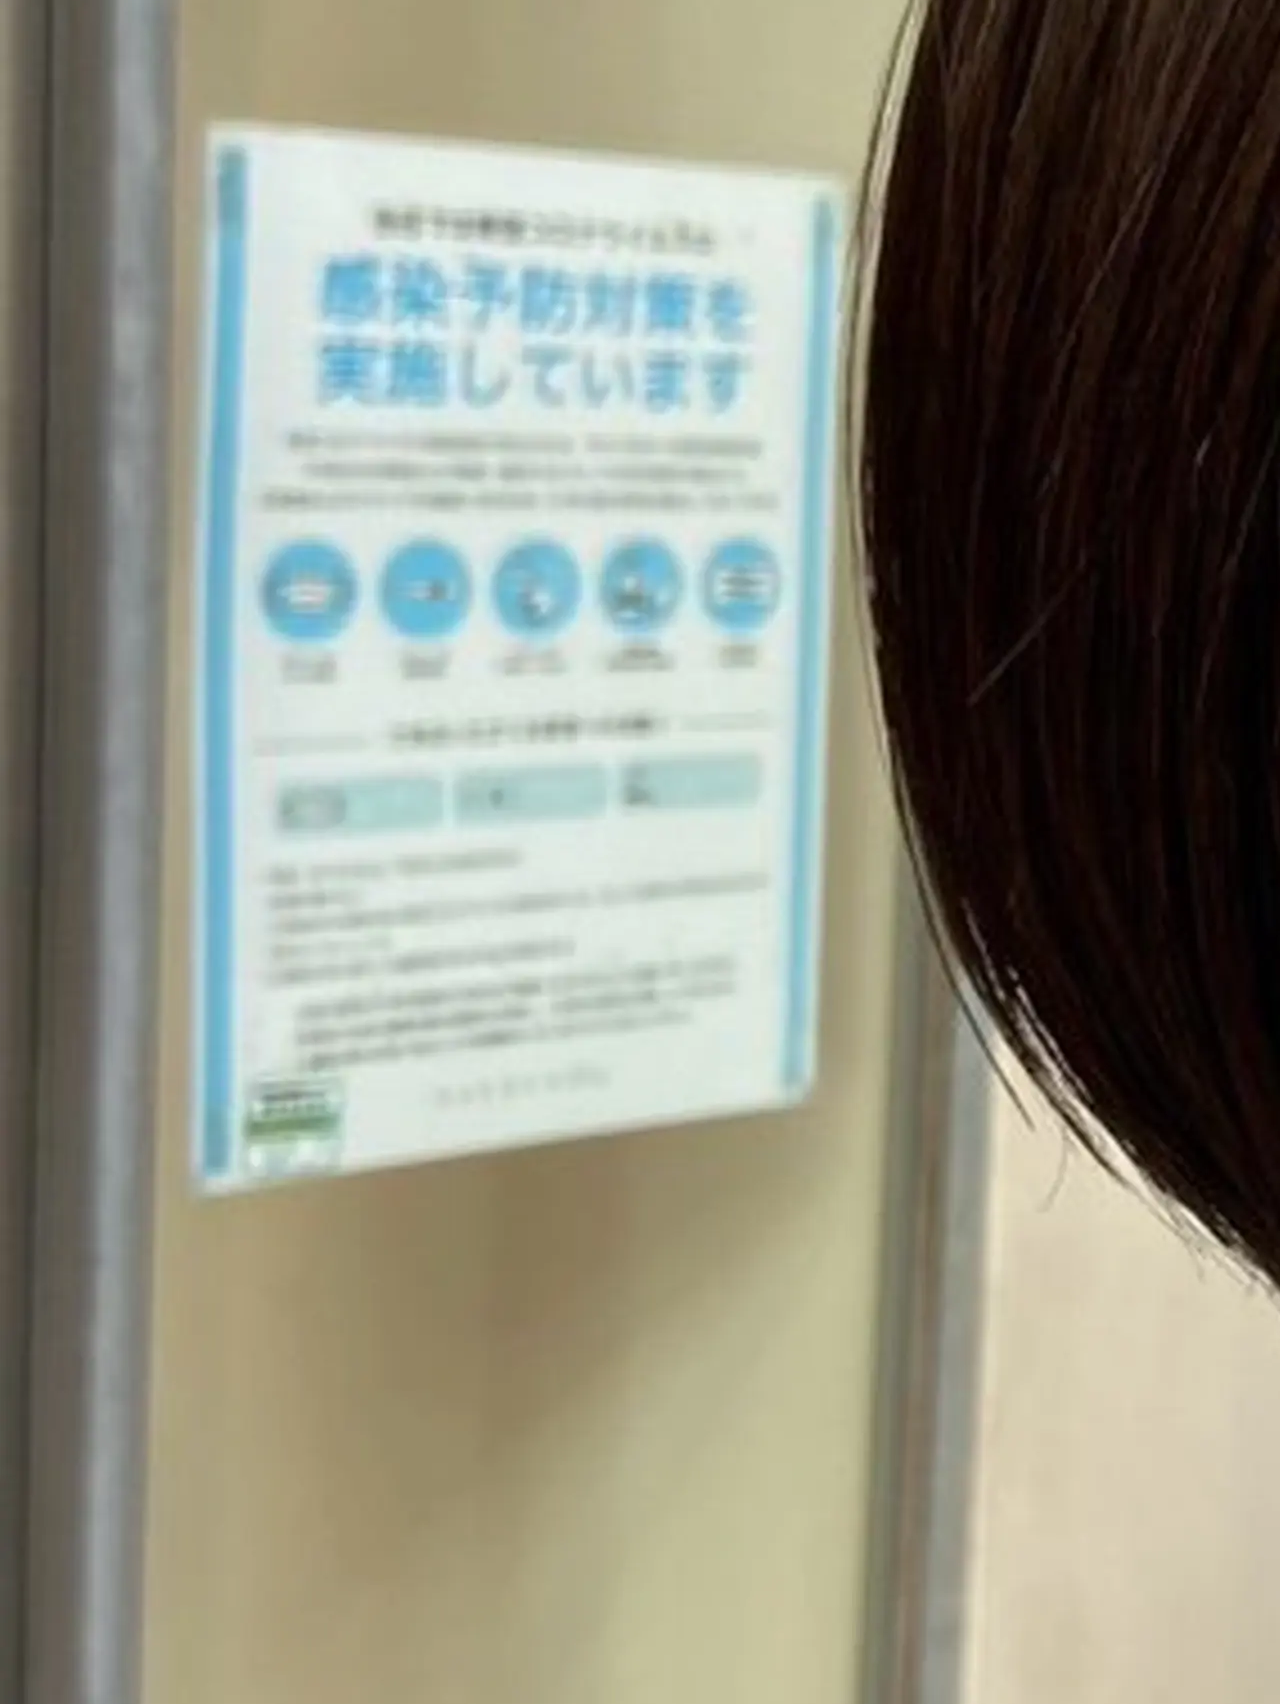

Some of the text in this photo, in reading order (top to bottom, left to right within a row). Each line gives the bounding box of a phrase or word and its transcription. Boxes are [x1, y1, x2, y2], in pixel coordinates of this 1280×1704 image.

[318, 339, 747, 410] 実施しています
